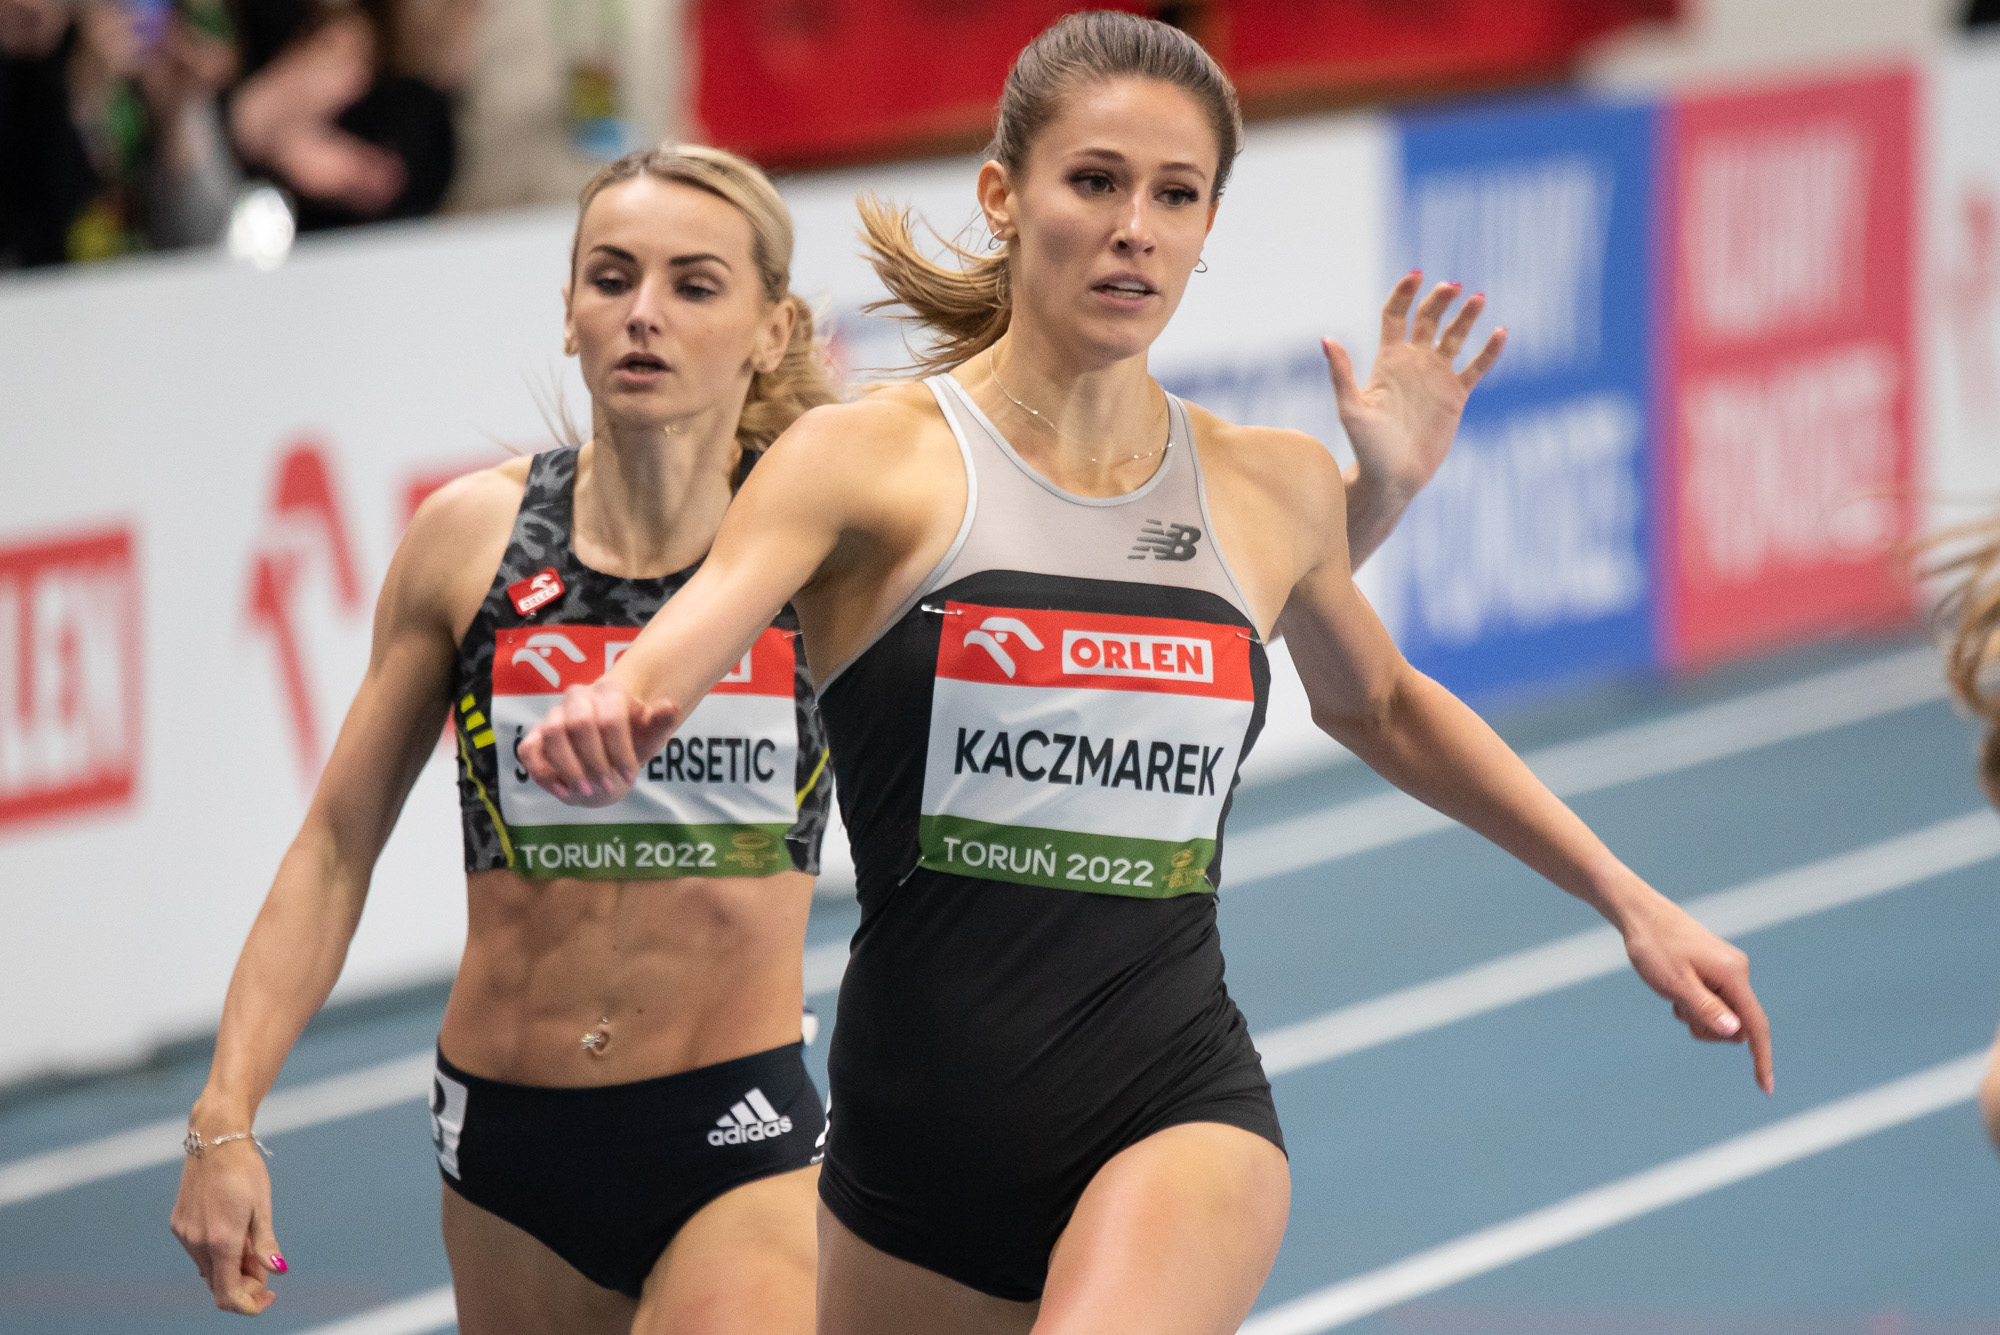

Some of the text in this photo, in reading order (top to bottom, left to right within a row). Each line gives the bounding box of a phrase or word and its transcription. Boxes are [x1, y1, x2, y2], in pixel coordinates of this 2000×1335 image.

[1069, 637, 1204, 675] ORLEN
[954, 727, 1225, 797] KACZMAREK
[520, 836, 626, 869] TORUŃ
[635, 842, 717, 868] 2022
[943, 837, 1155, 888] TORUŃ 2022
[707, 1115, 793, 1146] adidas
